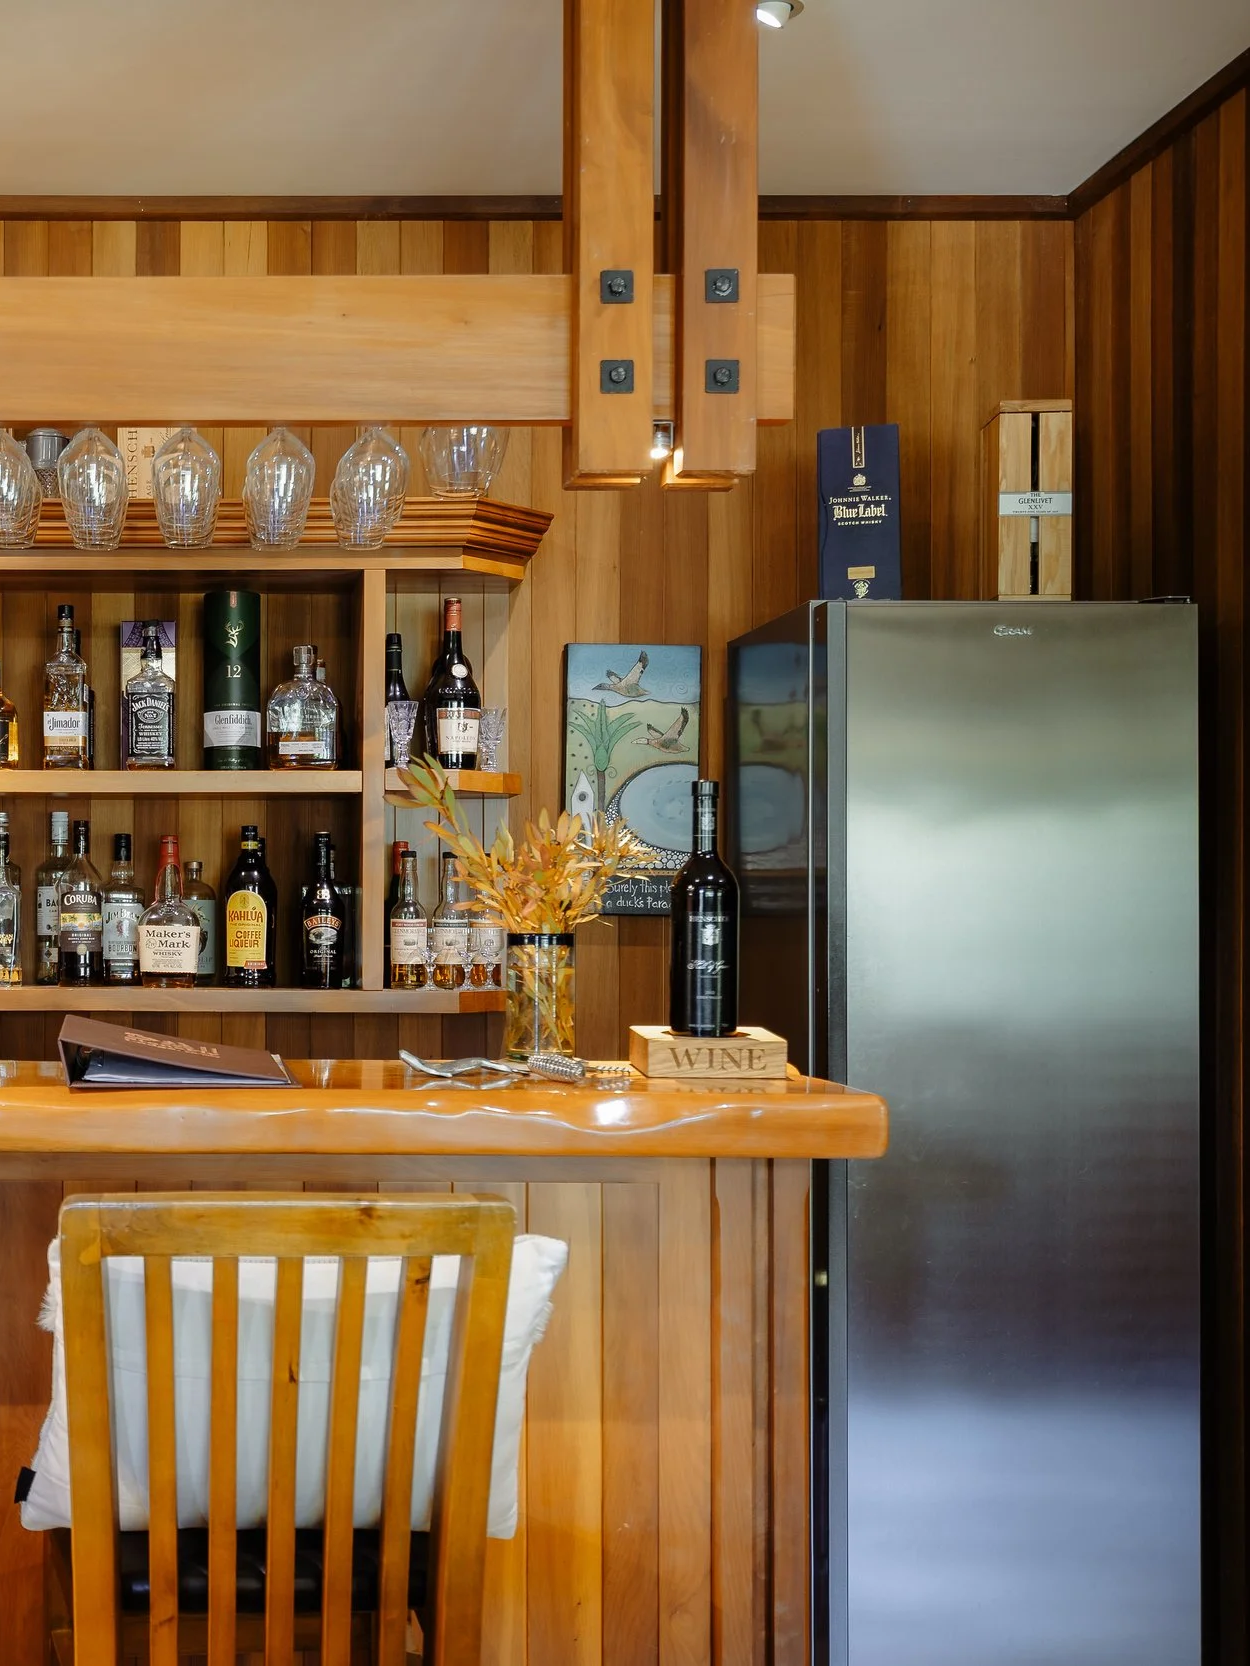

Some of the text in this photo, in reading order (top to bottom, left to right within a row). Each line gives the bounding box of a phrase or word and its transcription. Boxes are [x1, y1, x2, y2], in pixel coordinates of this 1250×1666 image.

[828, 496, 860, 504] JOHNNIE
[1018, 497, 1053, 505] GLENLIVET
[832, 505, 858, 521] Blue
[226, 665, 242, 678] 12
[132, 699, 147, 712] JACK
[49, 717, 81, 731] Jimador
[214, 714, 252, 725] Glenfiddich
[607, 878, 639, 897] Surely
[640, 879, 658, 893] this
[64, 894, 98, 906] CORUBA
[606, 899, 613, 909] a
[105, 908, 140, 924] JIM BEAM
[228, 906, 264, 922] KAHLÚA
[306, 917, 340, 927] BAILEYS
[145, 930, 191, 938] Maker's
[235, 931, 262, 939] COFFEE
[108, 944, 138, 952] BOURBON
[158, 940, 191, 949] Mark
[229, 939, 259, 948] LIQUEUR
[669, 1047, 767, 1072] WINE
